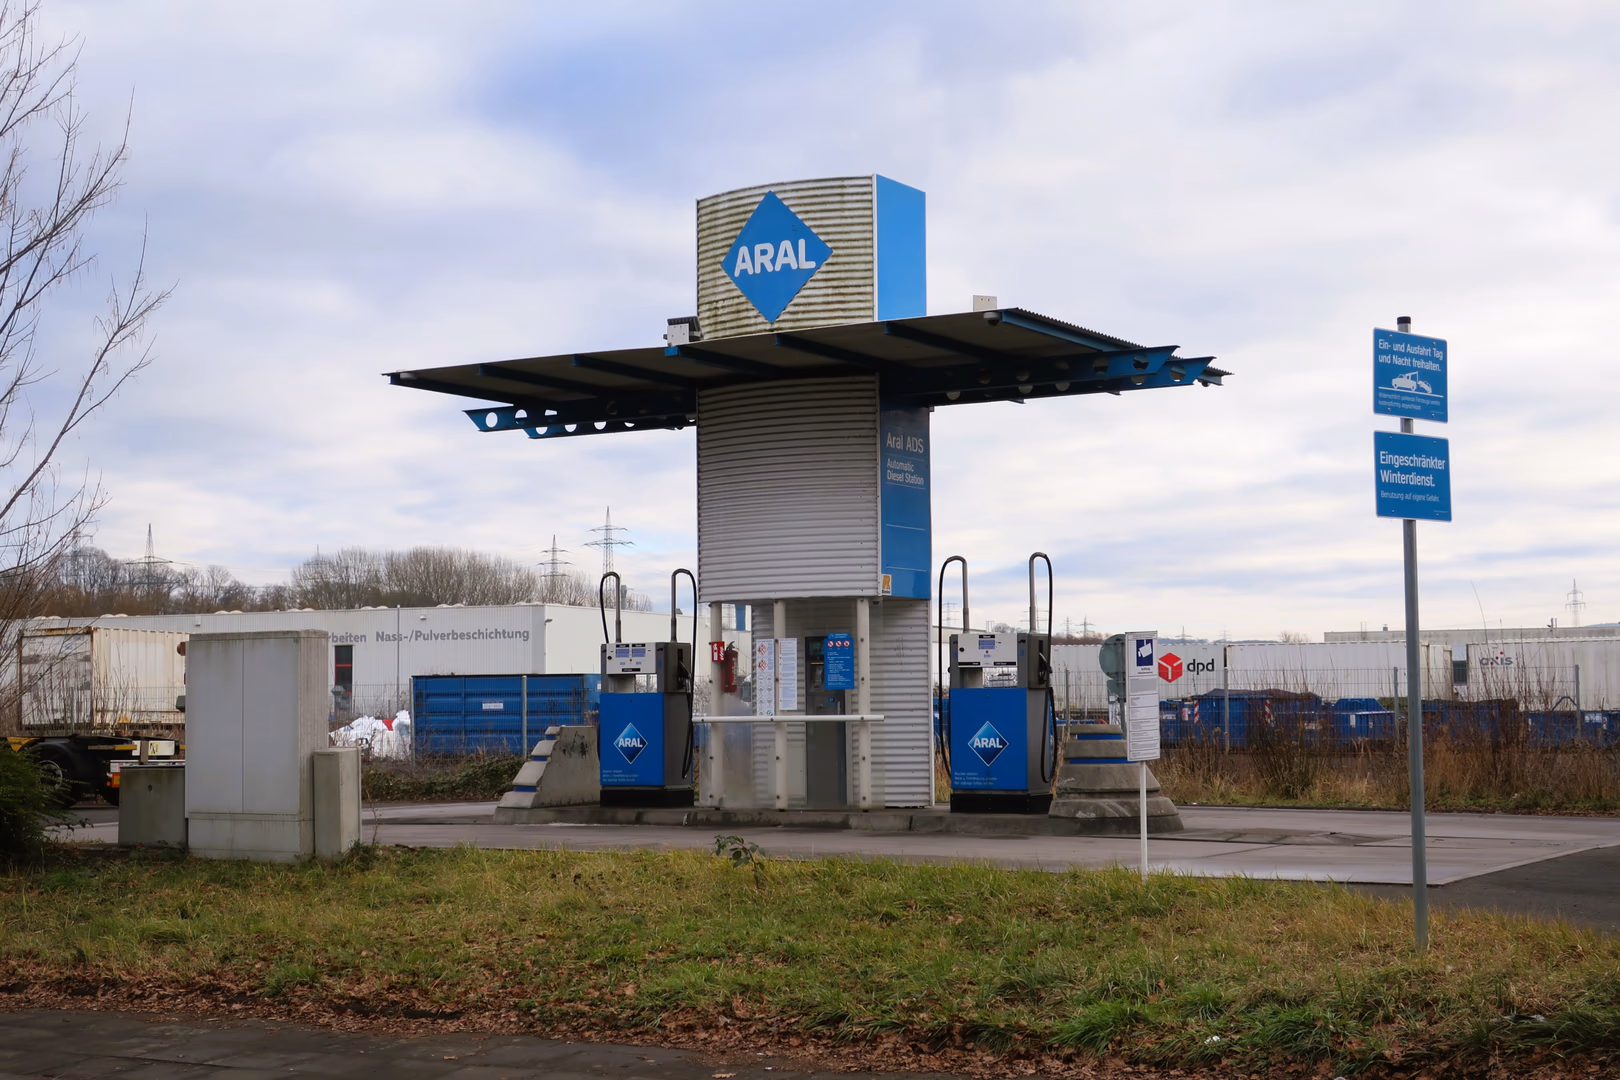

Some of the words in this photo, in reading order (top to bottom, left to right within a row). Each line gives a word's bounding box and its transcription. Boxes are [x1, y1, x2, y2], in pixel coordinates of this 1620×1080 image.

[734, 238, 816, 278] ARAL
[1378, 338, 1391, 350] Ein-
[1393, 342, 1405, 353] und
[1406, 344, 1432, 357] Ausfahrt
[1433, 347, 1443, 361] Tag
[1378, 354, 1391, 364] und
[1392, 354, 1411, 367] Nacht
[1412, 358, 1441, 372] freihalten.
[886, 432, 904, 450] Aral
[906, 435, 924, 454] ADS
[887, 458, 914, 473] Automatic
[1380, 451, 1446, 470] Eingeschränkter
[887, 469, 904, 482] Diesel
[905, 472, 924, 486] Station
[1380, 469, 1436, 487] Winterdienst.
[1380, 490, 1404, 501] Benutzung
[1187, 658, 1215, 675] dpd
[618, 737, 643, 748] ARAL
[973, 737, 1003, 749] ARAL
